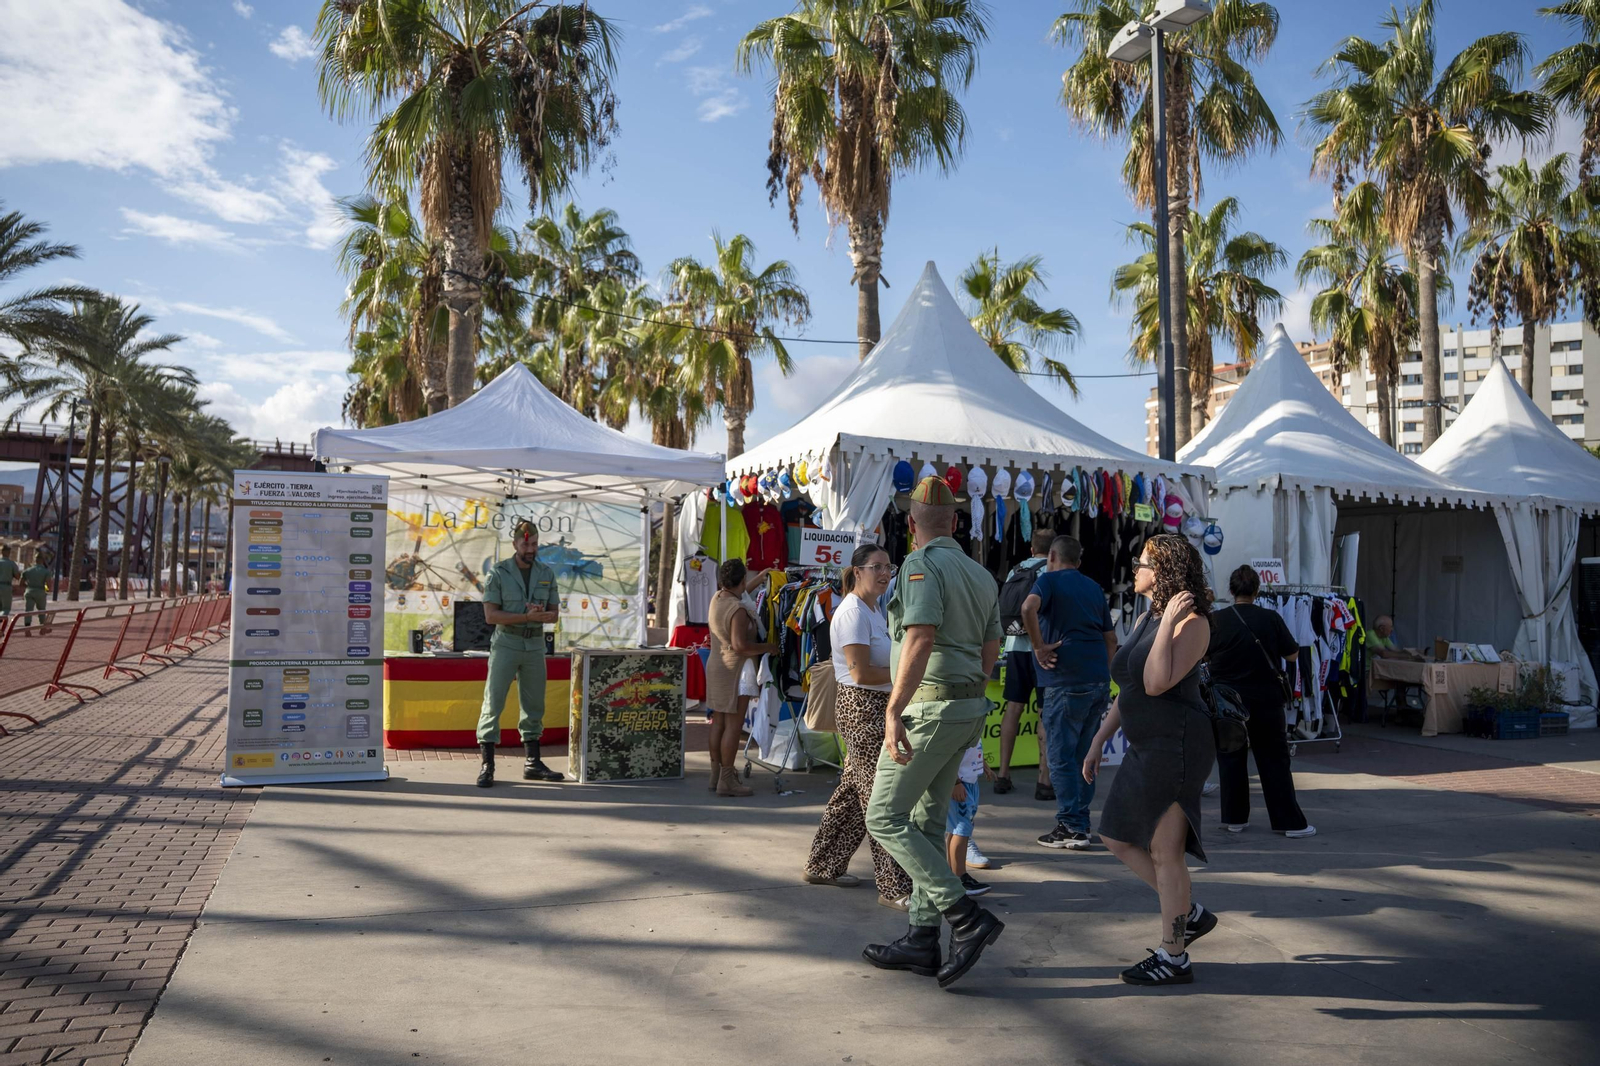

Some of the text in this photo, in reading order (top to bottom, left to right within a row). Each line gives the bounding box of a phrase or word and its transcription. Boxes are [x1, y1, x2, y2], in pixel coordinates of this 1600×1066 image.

[254, 481, 313, 491] EJÉRCITO TIERRA
[422, 502, 457, 529] La
[804, 532, 854, 544] LIQUIDACIÓN
[814, 545, 842, 564] 5€
[1253, 560, 1282, 568] LIQUIDACIÓN
[1259, 569, 1280, 584] 10€
[624, 720, 669, 731] TIERRA
